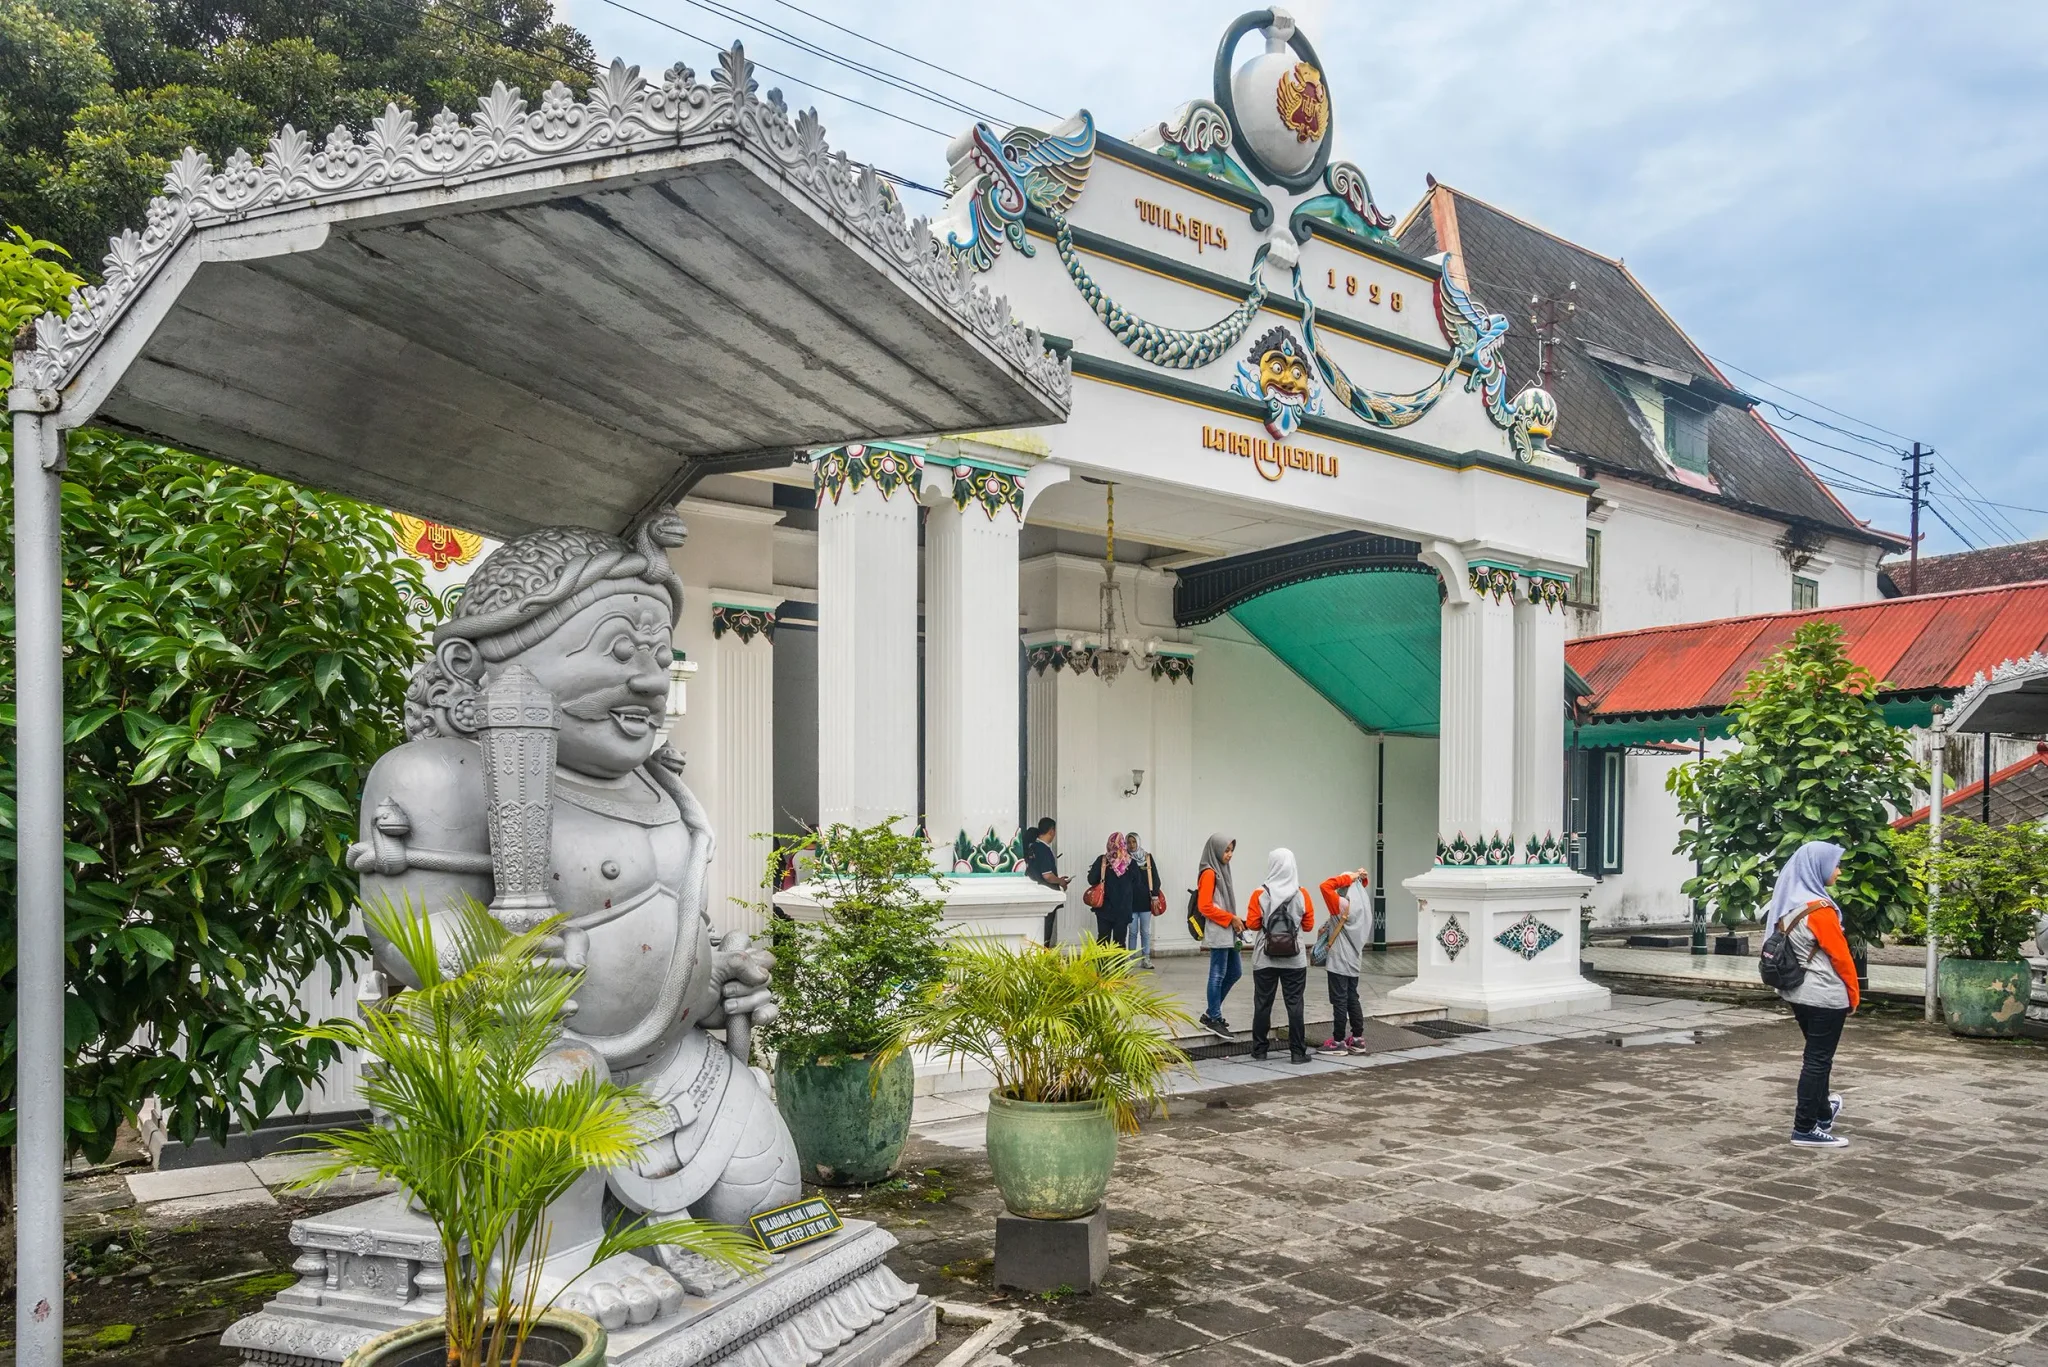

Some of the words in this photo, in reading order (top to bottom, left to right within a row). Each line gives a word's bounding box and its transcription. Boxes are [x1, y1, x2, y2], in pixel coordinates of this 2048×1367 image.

[1328, 268, 1403, 312] 1928
[759, 1213, 791, 1232] DILARANG
[788, 1208, 805, 1222] NAIK
[788, 1227, 804, 1241] STEP
[806, 1222, 818, 1234] SIT
[816, 1219, 827, 1232] ON
[825, 1217, 834, 1229] IT
